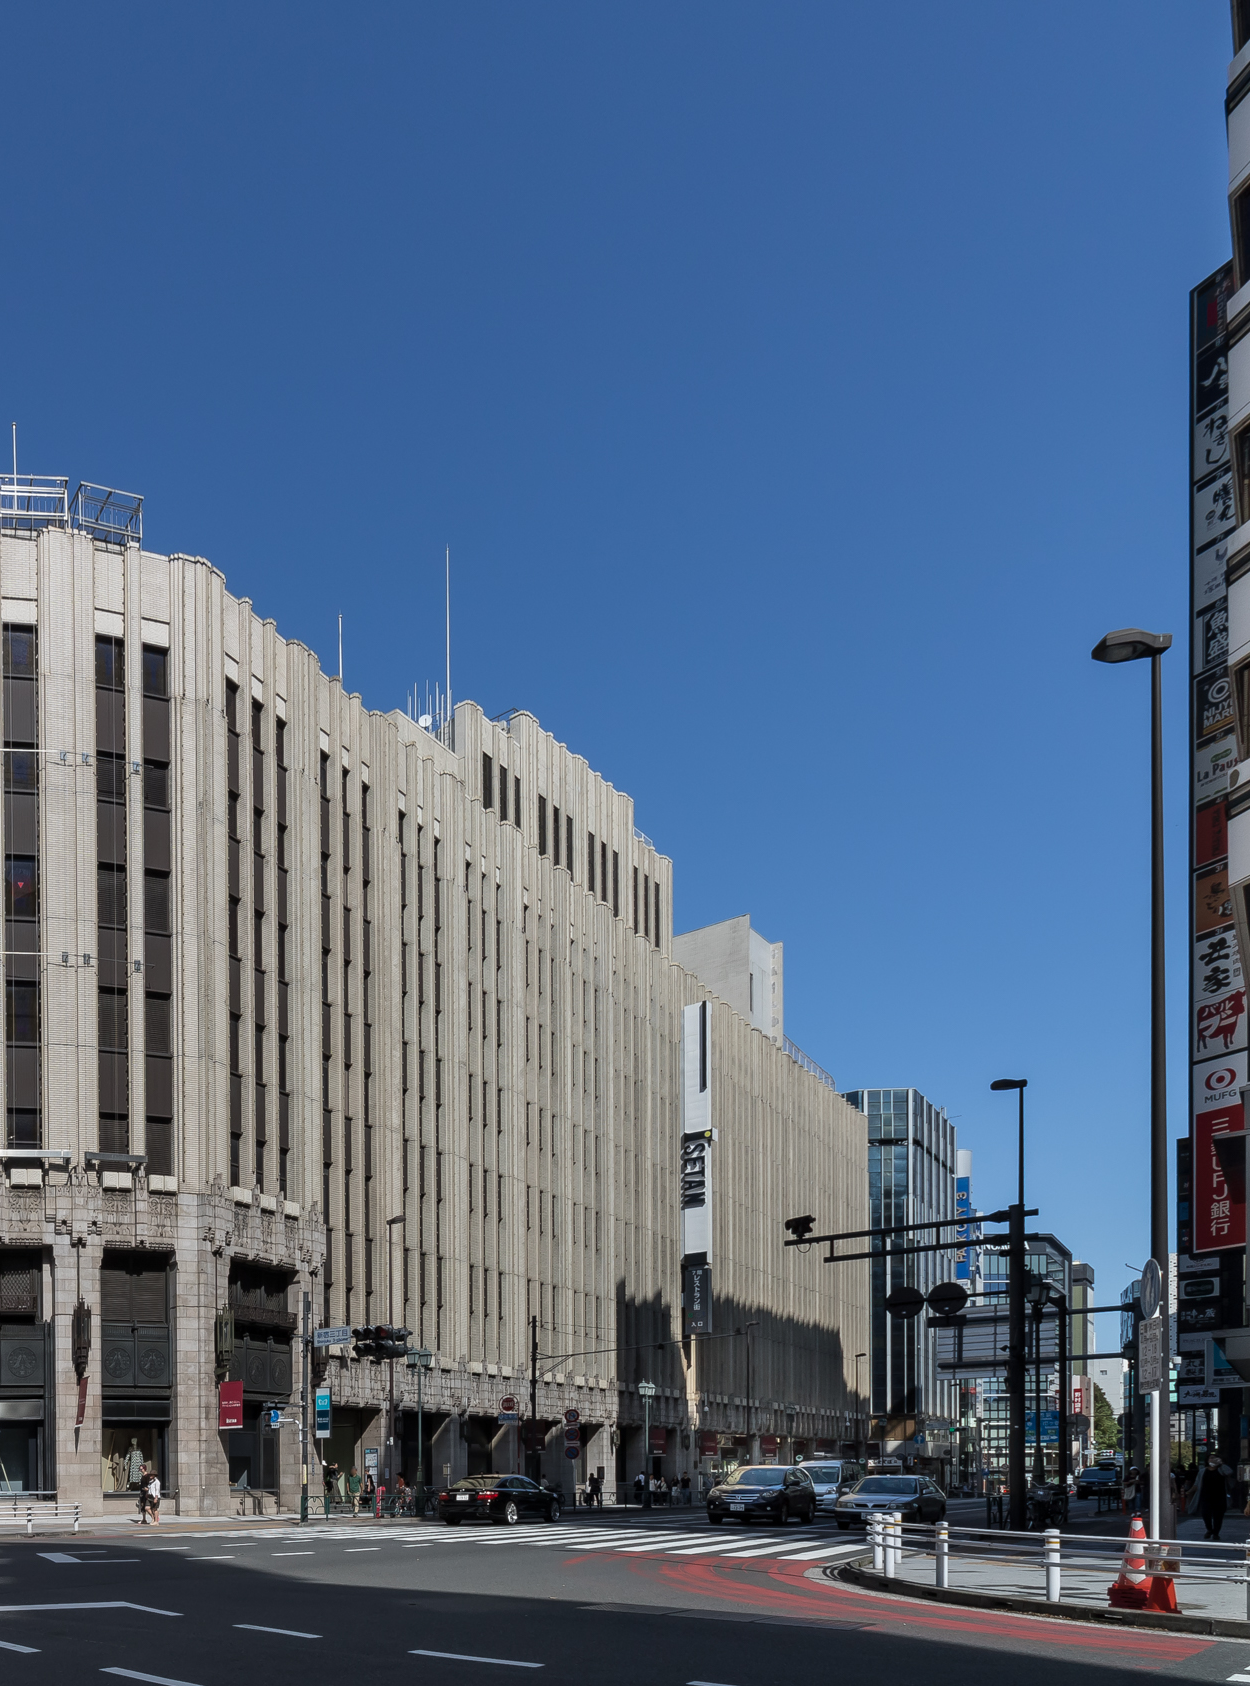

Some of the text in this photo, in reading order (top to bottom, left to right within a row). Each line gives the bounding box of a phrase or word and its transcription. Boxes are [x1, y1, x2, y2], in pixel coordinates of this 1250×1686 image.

[1203, 415, 1229, 465] ねぎし
[1197, 770, 1209, 783] La
[1204, 1089, 1237, 1104] MUFG
[682, 1130, 710, 1209] ISETAN
[1211, 1117, 1230, 1236] 三UFJ銀行
[317, 1329, 348, 1339] 新宿三丁目
